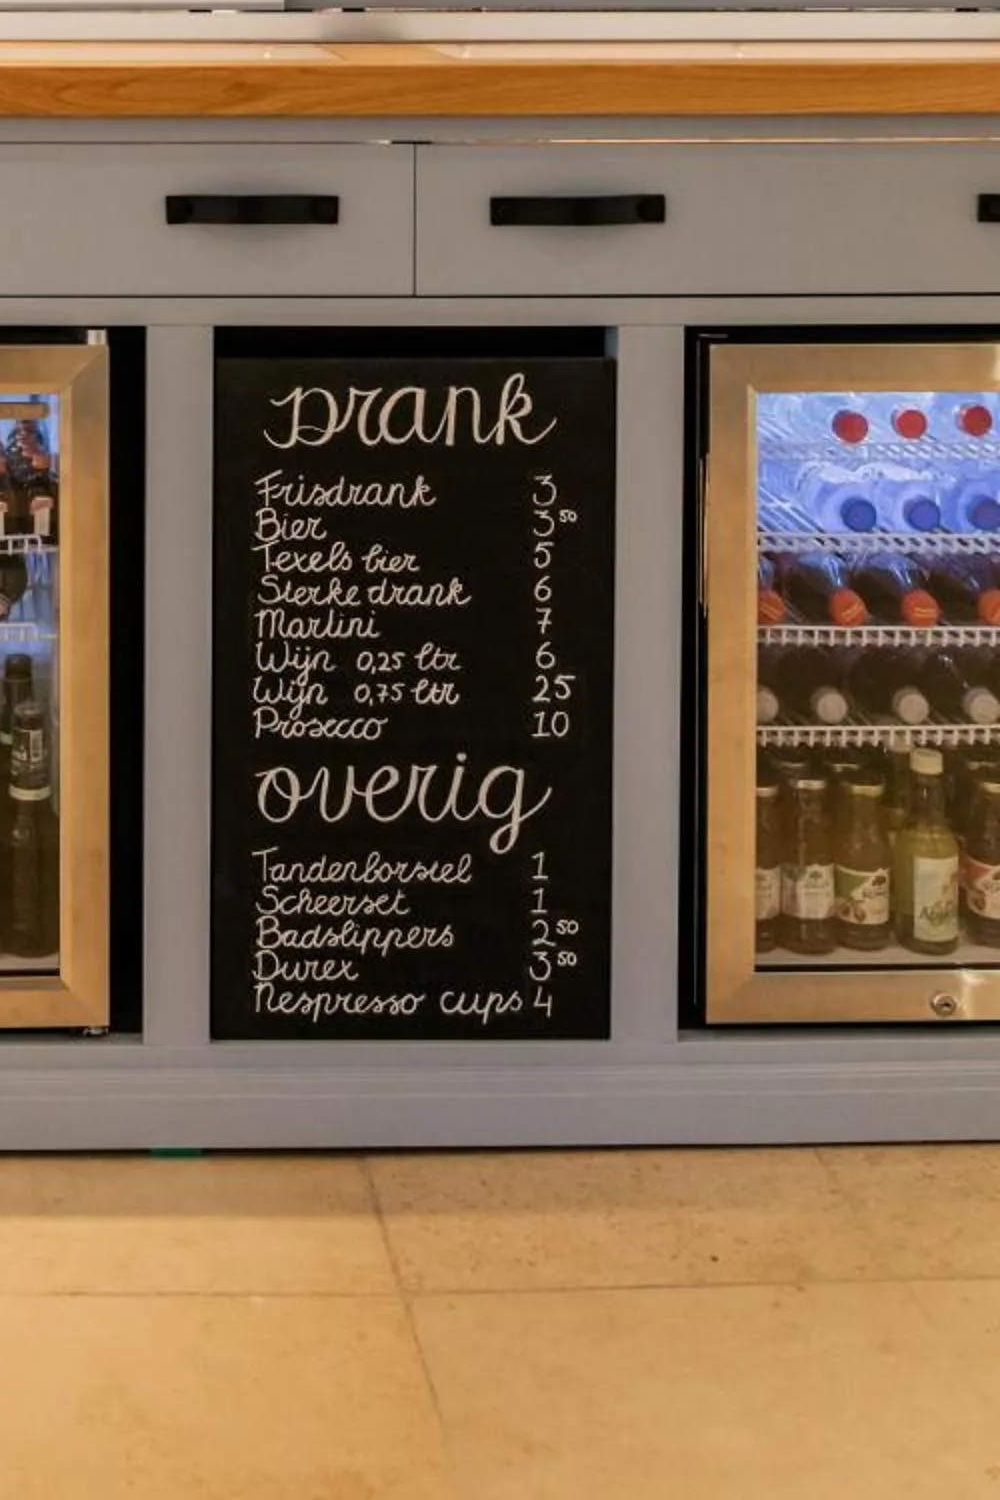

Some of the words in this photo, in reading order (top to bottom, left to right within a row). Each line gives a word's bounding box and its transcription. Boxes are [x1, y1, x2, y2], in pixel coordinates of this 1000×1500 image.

[255, 470, 437, 508] Frisdrank
[533, 475, 558, 507] 3
[254, 508, 327, 542] Bier
[252, 540, 352, 573] Texels
[362, 545, 420, 572] bier
[533, 542, 554, 569] 5
[257, 575, 359, 606] Sterke
[367, 578, 472, 606] drank
[534, 575, 551, 600] 6
[254, 610, 380, 638] Martini
[536, 607, 552, 635] 7
[254, 641, 336, 685] Wijn
[414, 643, 462, 672] ltr
[535, 643, 555, 669] 6
[253, 677, 328, 720] Wijn
[410, 677, 460, 705] ltr
[532, 676, 575, 703] 25
[254, 706, 388, 740] Prosecco
[532, 711, 569, 737] 10
[255, 752, 552, 854] overig
[252, 847, 472, 883] Tandenborstel
[531, 851, 548, 880] 1
[256, 886, 410, 915] Scheerset
[530, 888, 548, 913] 1
[255, 916, 454, 957] Badslippers
[252, 950, 359, 981] Durex
[254, 983, 425, 1022] Nespresso
[440, 990, 522, 1025] cups
[533, 987, 551, 1017] 4
